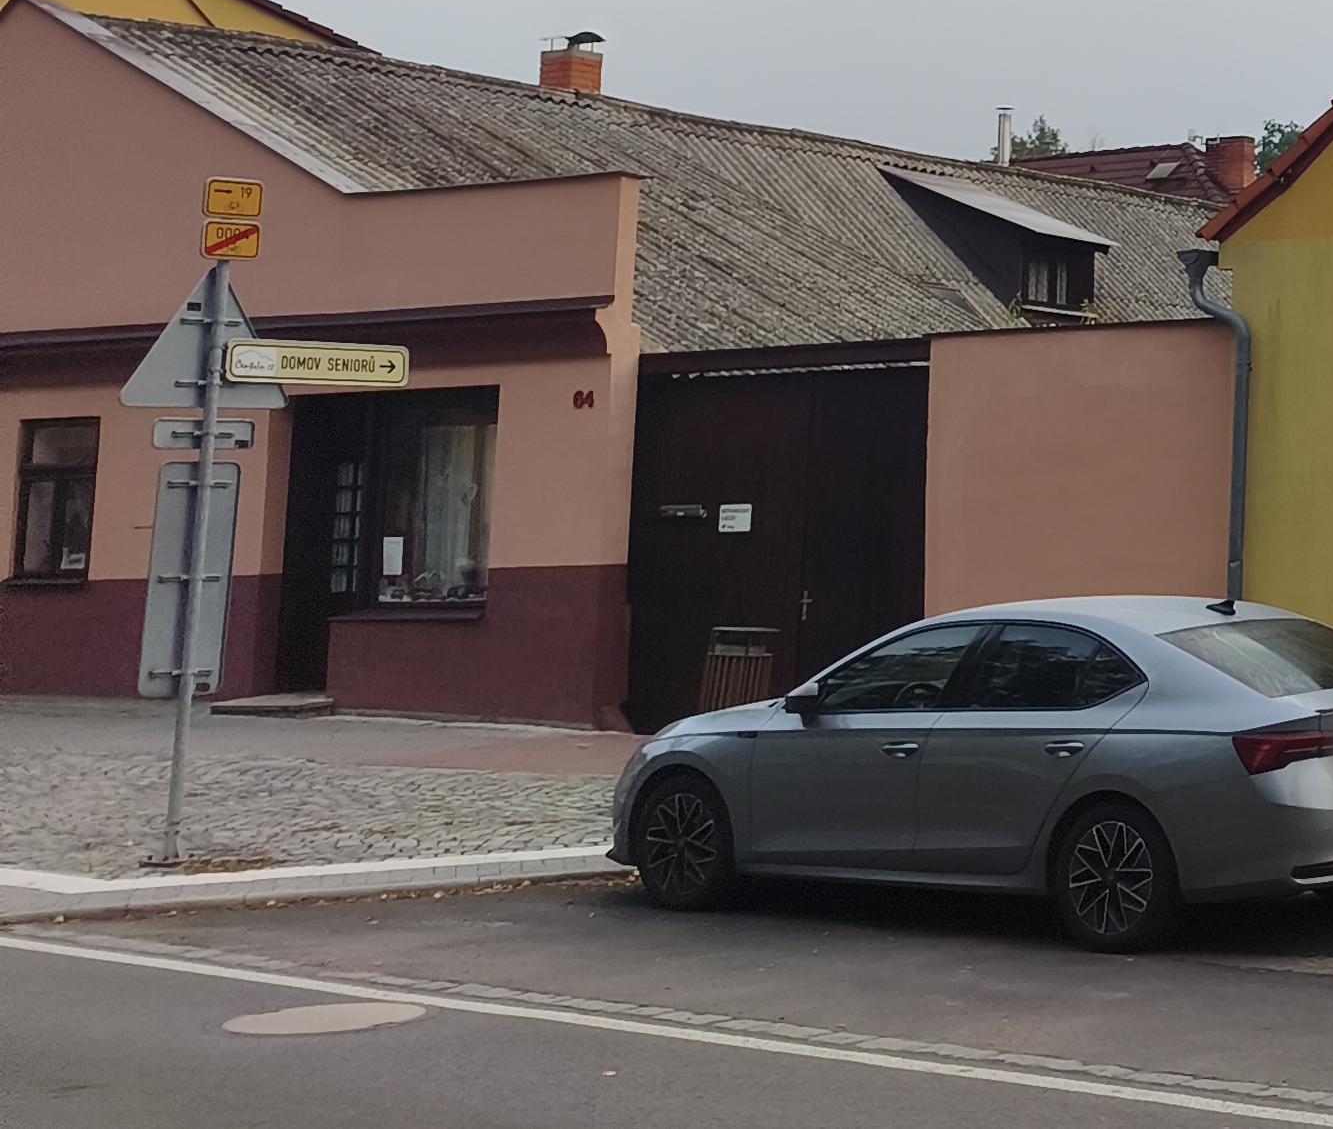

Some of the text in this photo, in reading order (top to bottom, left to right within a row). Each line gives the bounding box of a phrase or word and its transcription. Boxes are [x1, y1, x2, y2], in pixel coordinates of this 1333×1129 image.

[241, 186, 253, 199] 19
[281, 355, 321, 370] DOMOV
[327, 355, 375, 372] SENIORŮ
